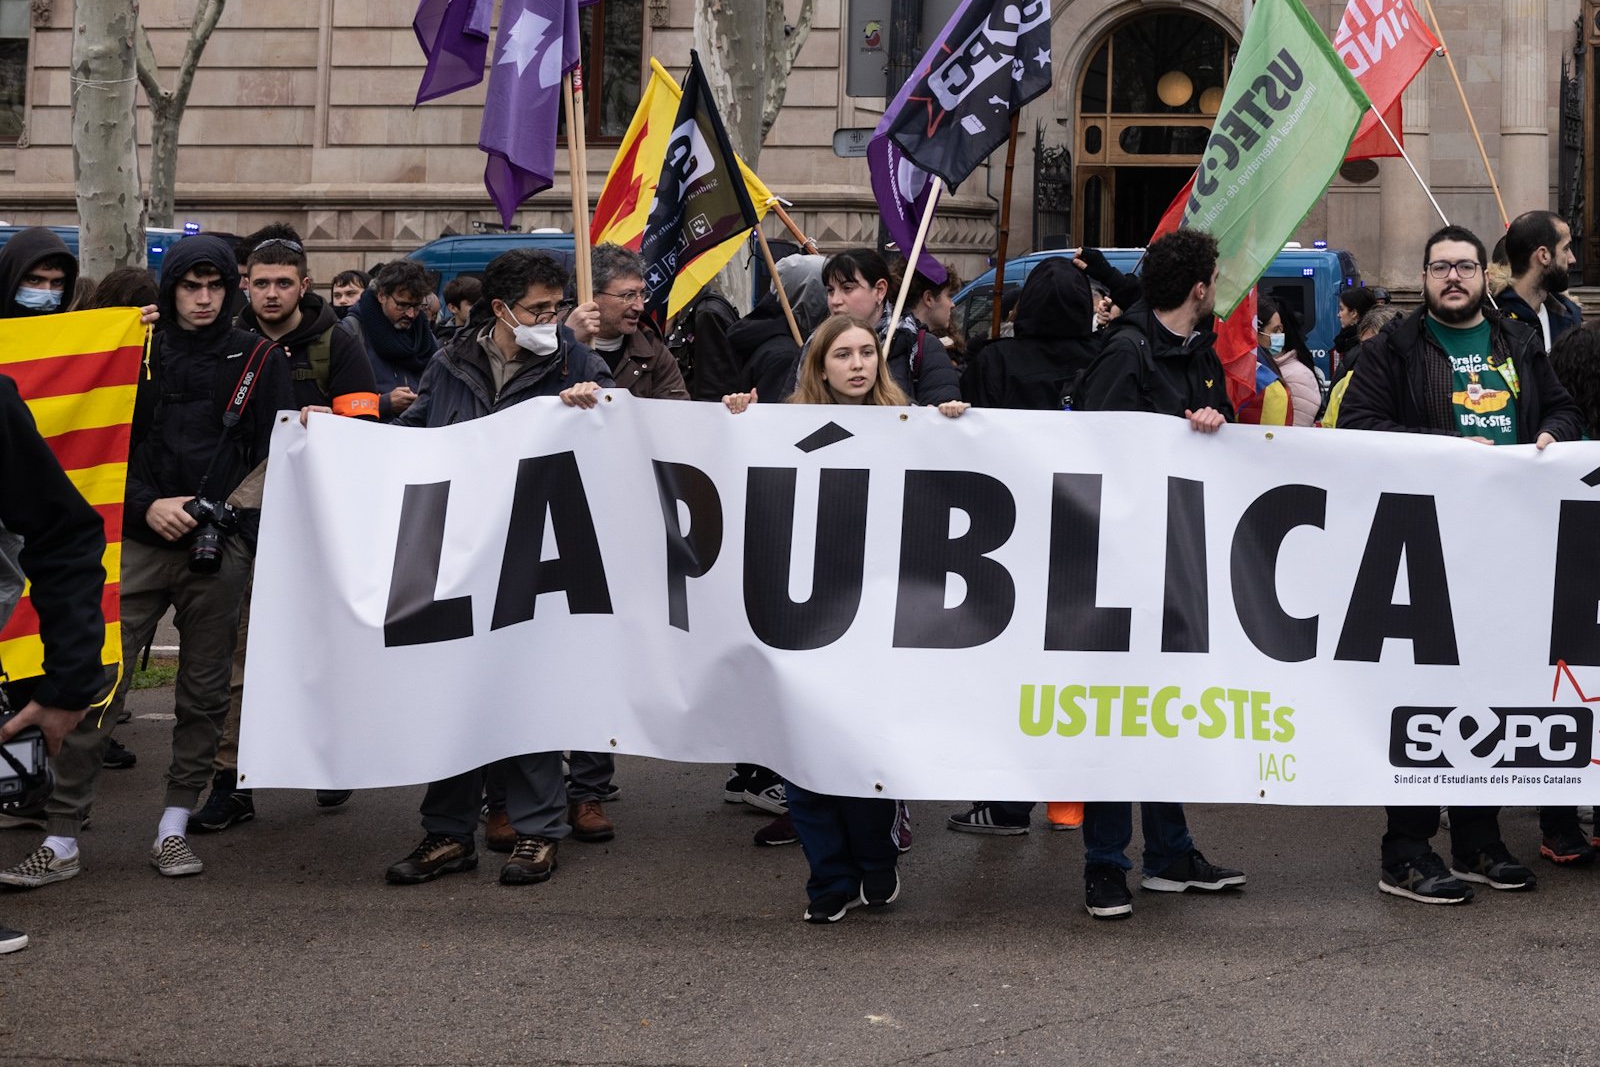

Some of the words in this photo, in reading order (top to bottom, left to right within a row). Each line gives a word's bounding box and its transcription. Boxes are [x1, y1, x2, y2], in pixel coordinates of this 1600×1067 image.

[234, 386, 247, 406] EOS
[383, 450, 614, 648] LA
[651, 420, 1460, 666] PÚBLICA
[1019, 684, 1296, 743] USTEC·STEs
[1258, 752, 1297, 782] IAC
[1394, 774, 1431, 784] Sindicat
[1490, 774, 1509, 784] dels
[1511, 774, 1541, 784] Països
[1543, 774, 1582, 784] Catalans
